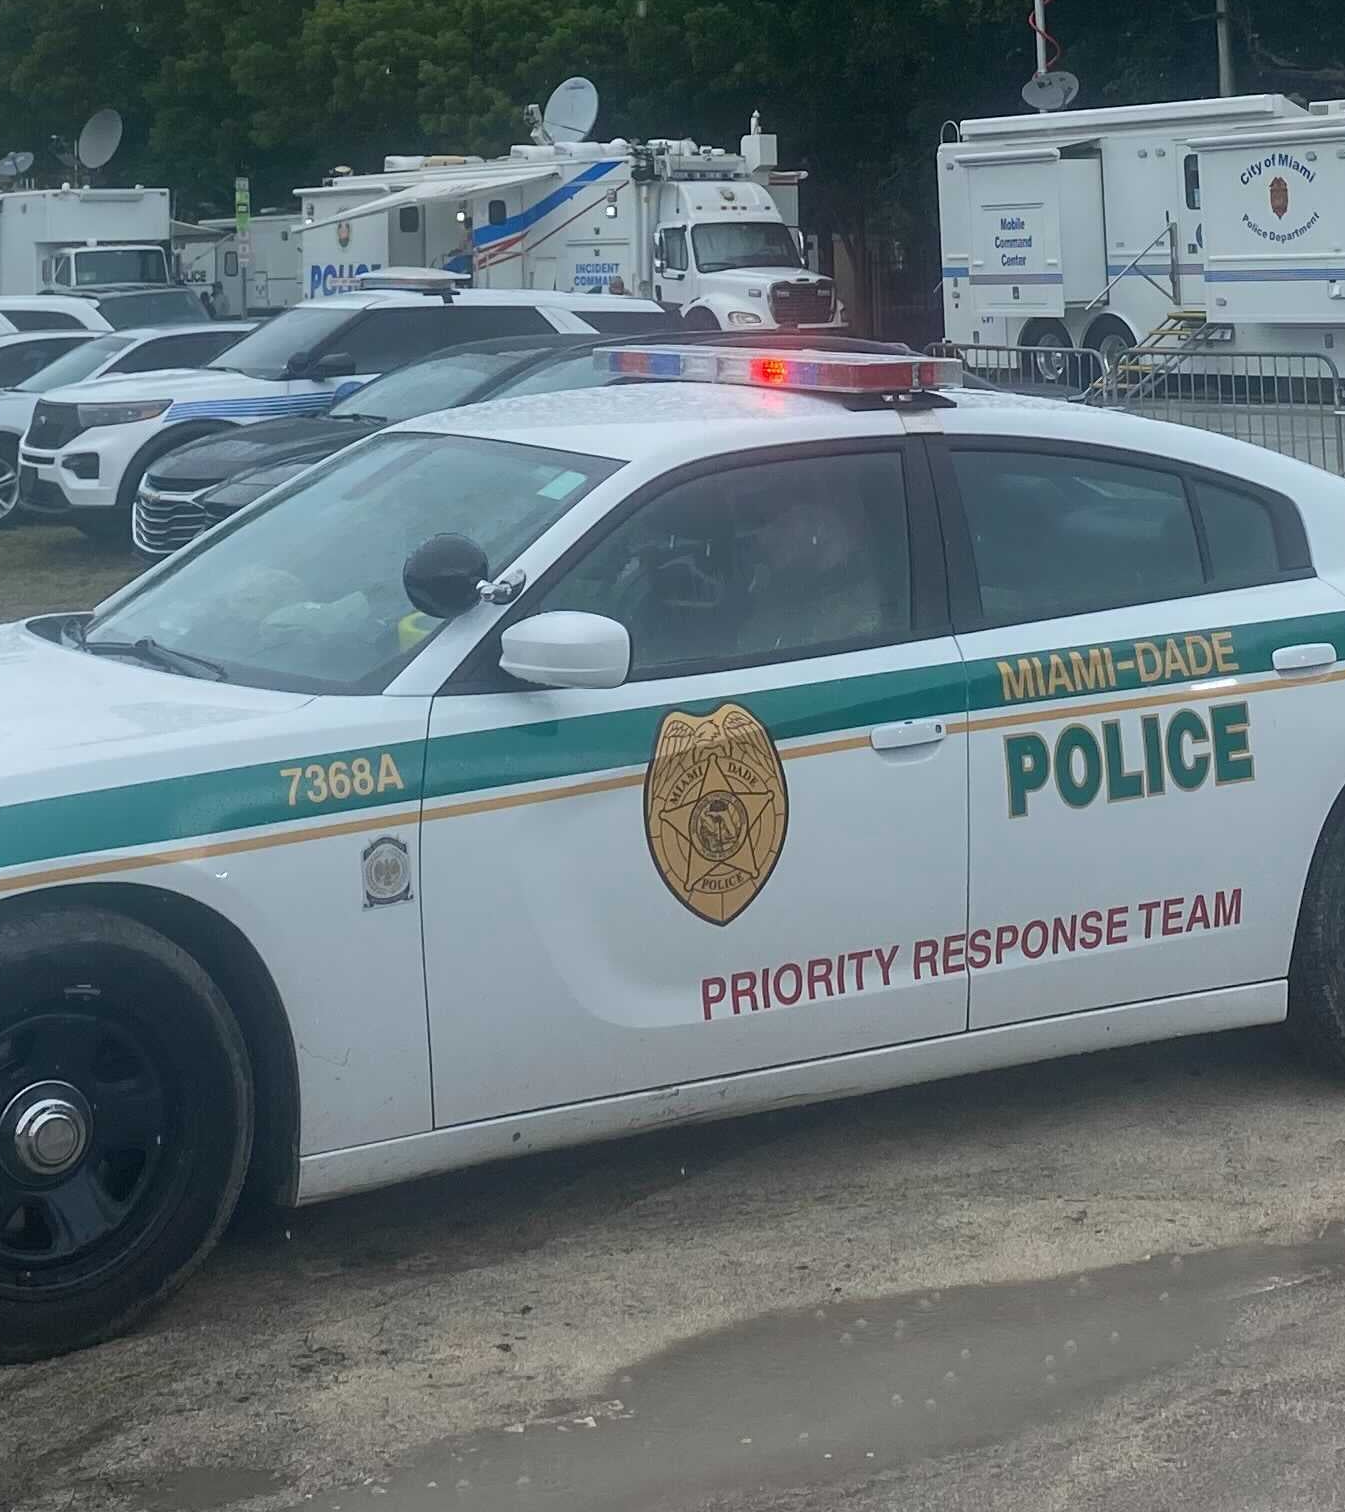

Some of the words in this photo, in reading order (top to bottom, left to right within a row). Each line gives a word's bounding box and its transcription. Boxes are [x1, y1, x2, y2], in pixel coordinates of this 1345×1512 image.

[1240, 161, 1262, 185] City
[1264, 153, 1276, 168] of
[1278, 153, 1316, 183] Miami
[1000, 218, 1025, 230] Mobile
[1242, 213, 1268, 239] Police
[1269, 211, 1320, 244] Department
[994, 235, 1032, 248] Command
[575, 263, 620, 274] INCIDENT
[1001, 254, 1027, 266] Center
[997, 631, 1240, 700] MIAMI-DADE
[1003, 701, 1256, 819] POLICE
[280, 753, 405, 806] 7368A
[669, 764, 704, 804] MIAMI
[727, 761, 760, 786] DADE
[701, 871, 745, 890] POLICE
[702, 945, 900, 1020] PRIORITY
[913, 906, 1129, 980] RESPONSE
[1138, 888, 1242, 939] TEAM
